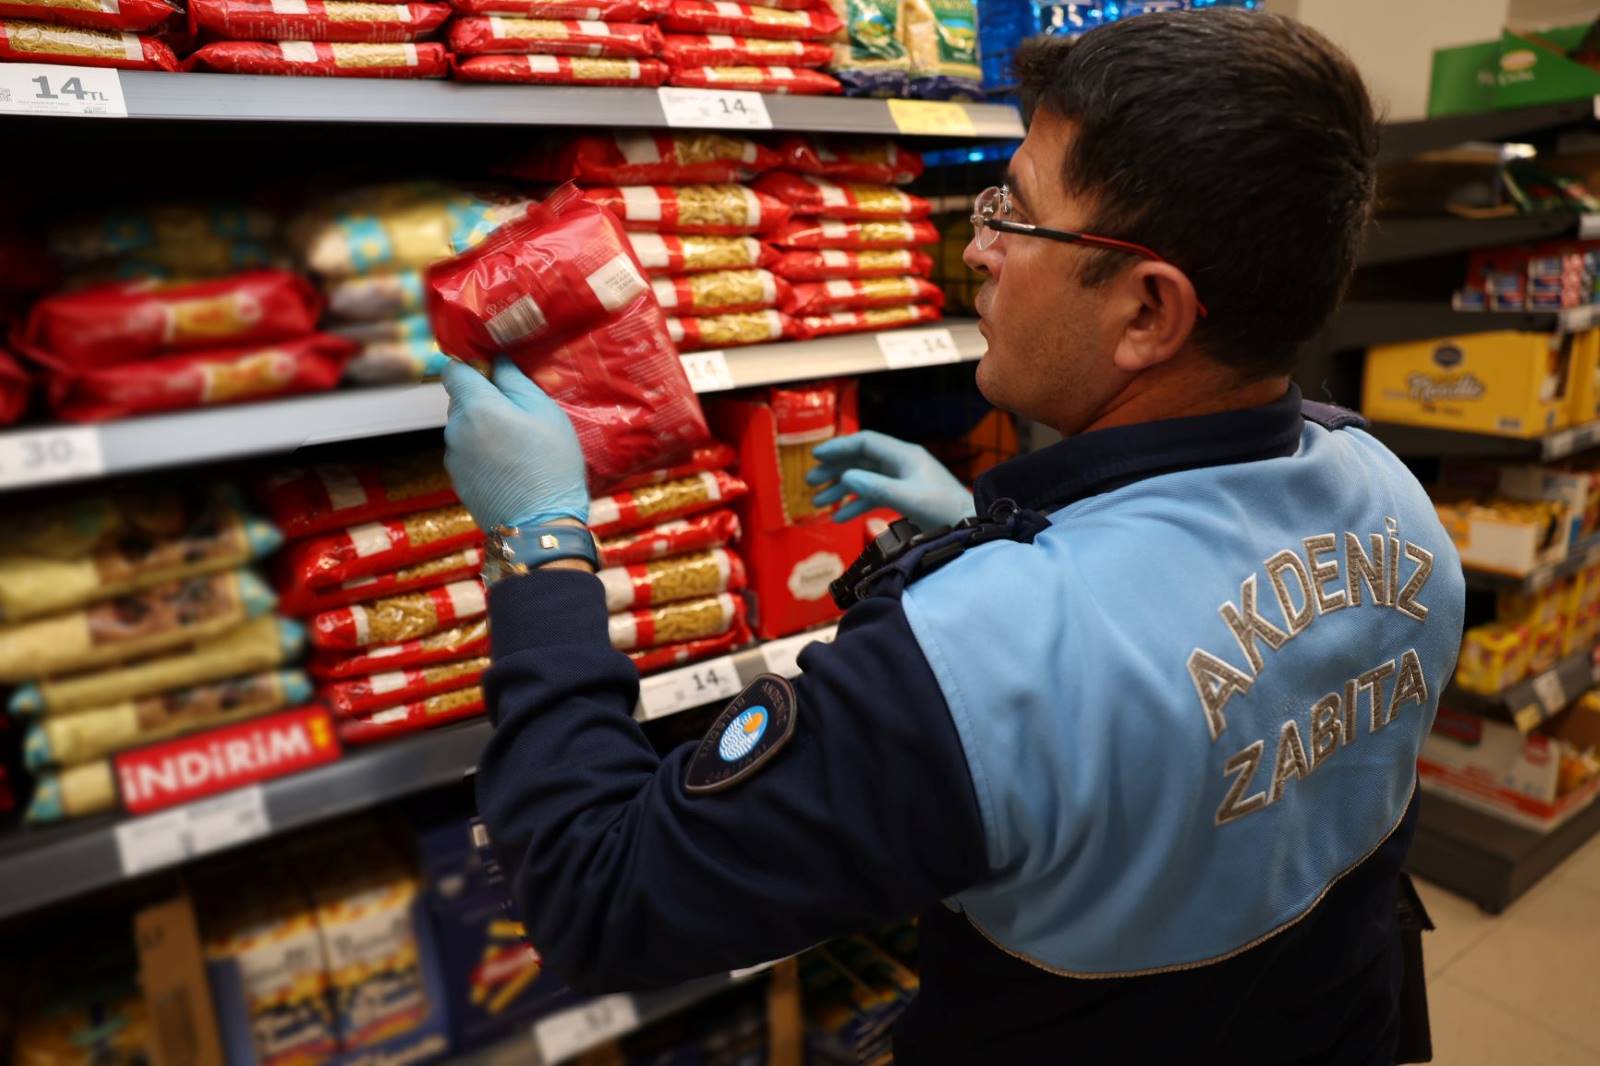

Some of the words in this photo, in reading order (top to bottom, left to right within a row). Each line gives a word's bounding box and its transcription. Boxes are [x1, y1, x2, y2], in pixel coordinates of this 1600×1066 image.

[718, 98, 747, 114] 14
[1186, 516, 1434, 743] AKDENİZ
[692, 669, 719, 691] 14
[1215, 648, 1428, 827] ZABITA
